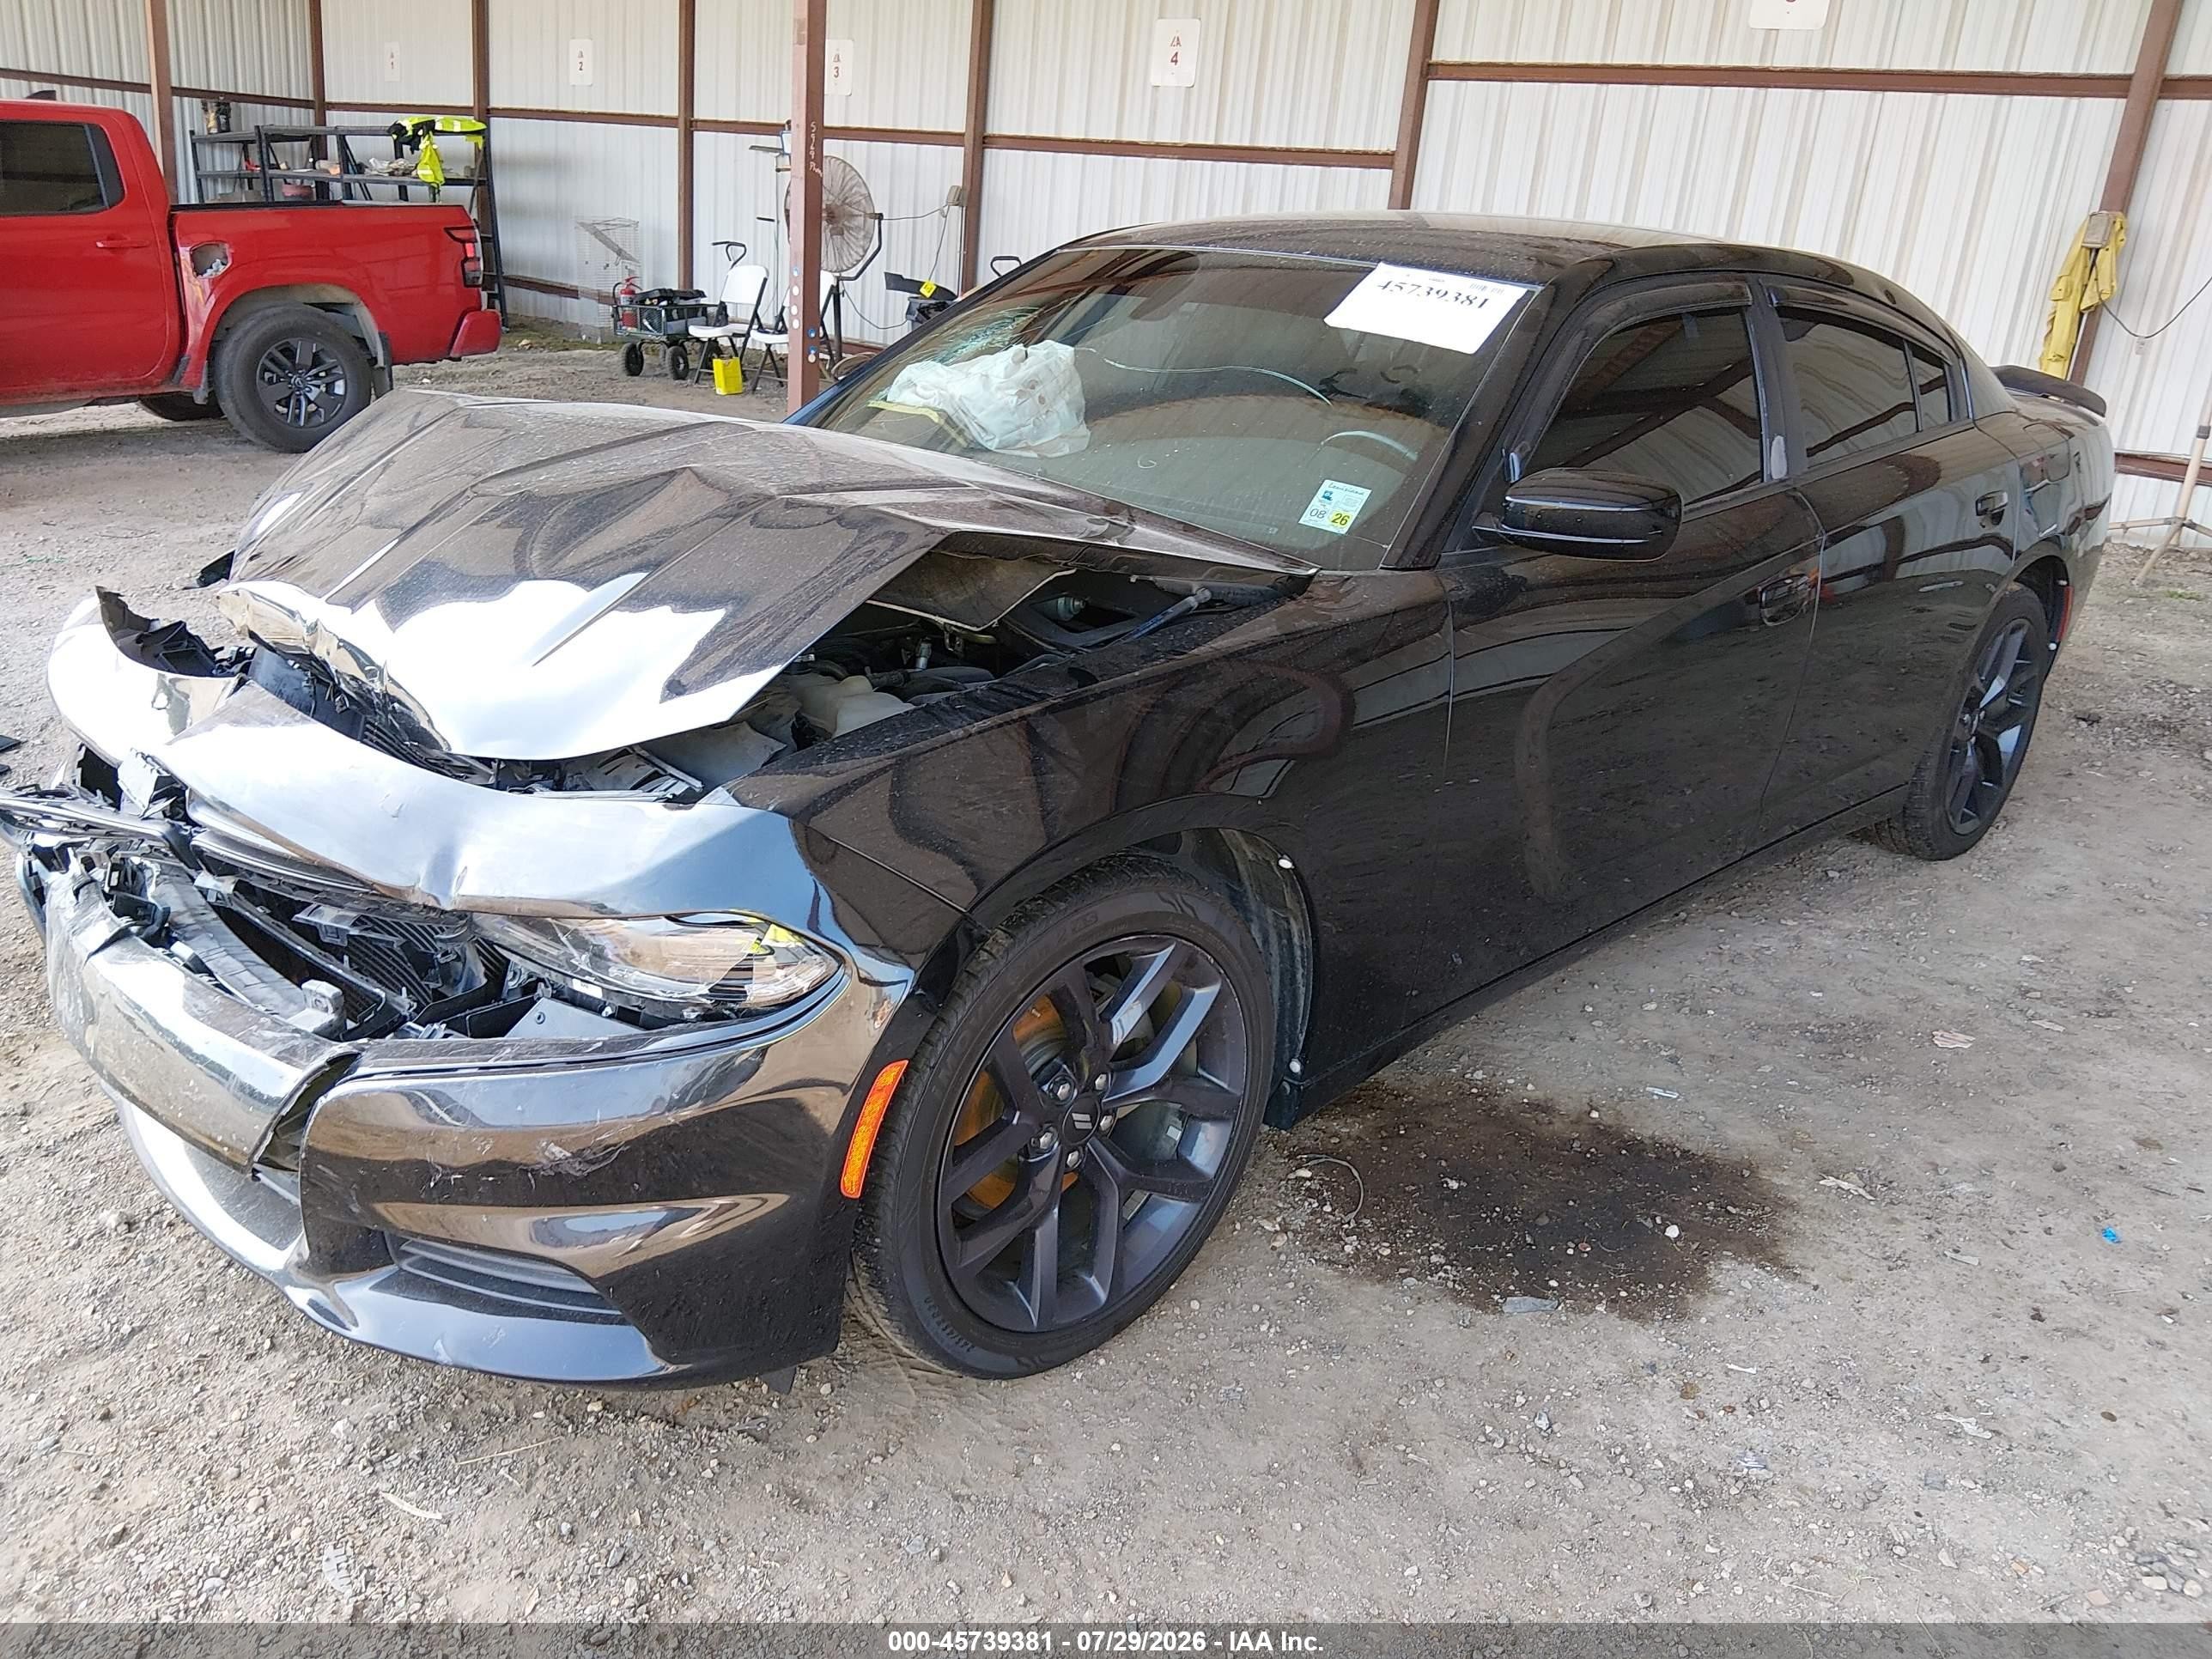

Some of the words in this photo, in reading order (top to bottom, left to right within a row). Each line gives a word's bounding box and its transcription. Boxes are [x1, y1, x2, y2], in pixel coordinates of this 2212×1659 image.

[1170, 52, 1179, 66] 4
[834, 66, 839, 78] 3
[1376, 280, 1490, 309] 45739381
[1310, 508, 1327, 519] 08
[1332, 513, 1351, 526] 26
